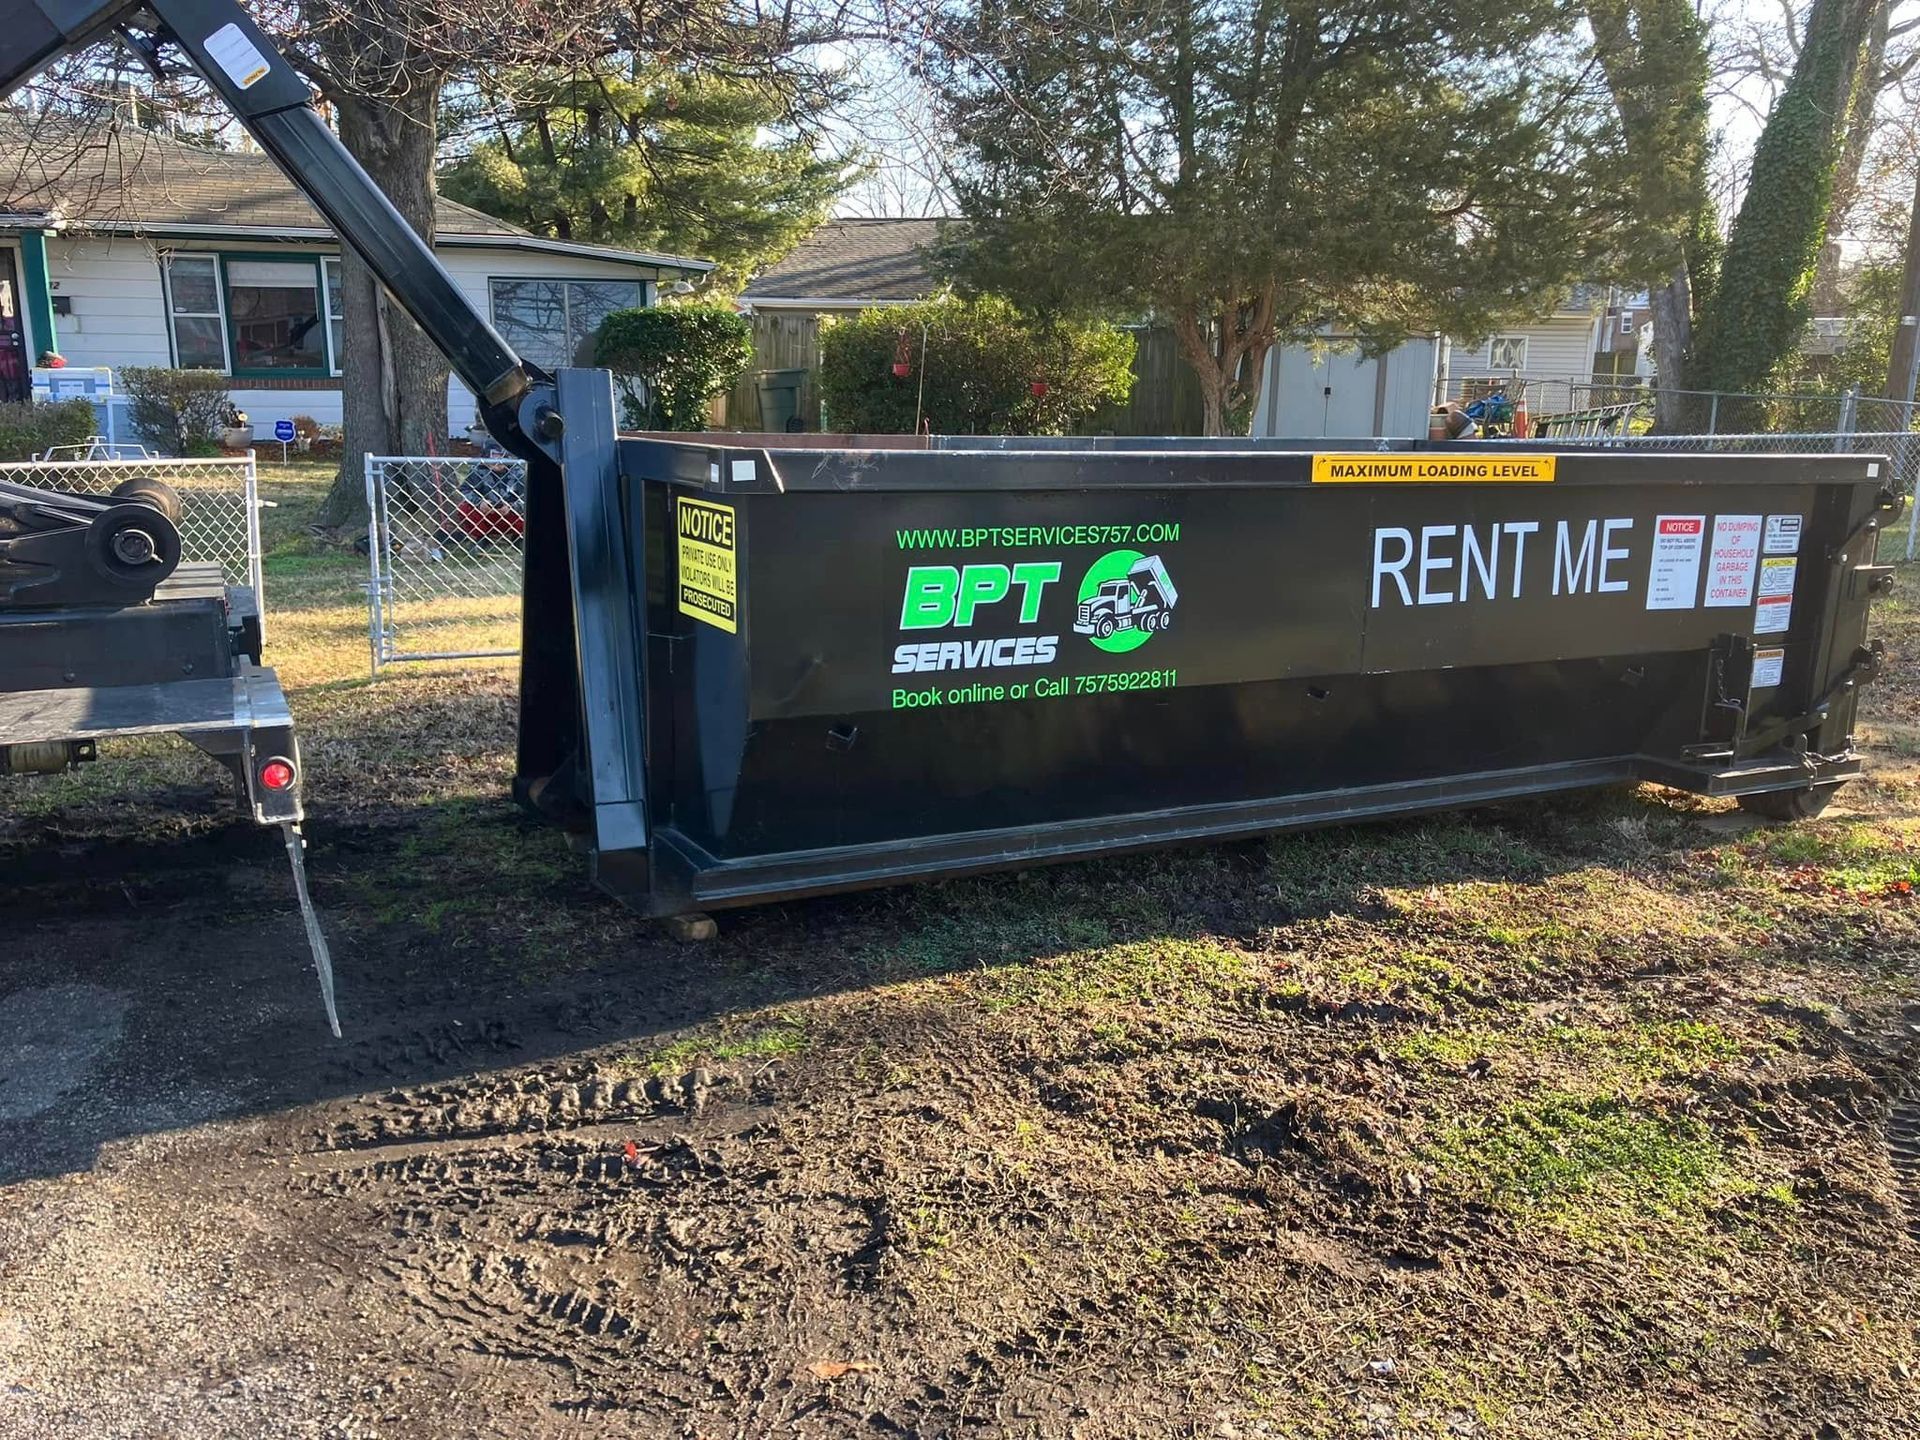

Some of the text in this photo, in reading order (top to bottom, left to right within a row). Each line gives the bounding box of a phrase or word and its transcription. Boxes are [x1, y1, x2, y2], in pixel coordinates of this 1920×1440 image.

[1330, 464, 1539, 478] MAXIMUM LOADING LEVEL
[681, 506, 732, 546] NOTICE
[896, 523, 1180, 549] WWW.BPTSERVICES757.COM
[1666, 522, 1695, 532] NOTICE
[1717, 522, 1758, 532] NO DUMPING
[1714, 548, 1755, 558] HOUSEHOLD
[1731, 535, 1741, 545] OF
[682, 545, 732, 573] PRIVATE USE ONLY
[1371, 518, 1634, 608] RENT ME
[1716, 562, 1748, 572] GARBAGE
[682, 565, 734, 596] VIOLATORS WILL BE
[1719, 575, 1742, 585] IN THIS
[683, 588, 731, 617] PROSECUTED
[899, 561, 1062, 630] BPT
[1711, 588, 1748, 599] CONTAINER
[891, 635, 1059, 673] SERVICES
[892, 669, 1177, 708] Book online or Call 7575922811
